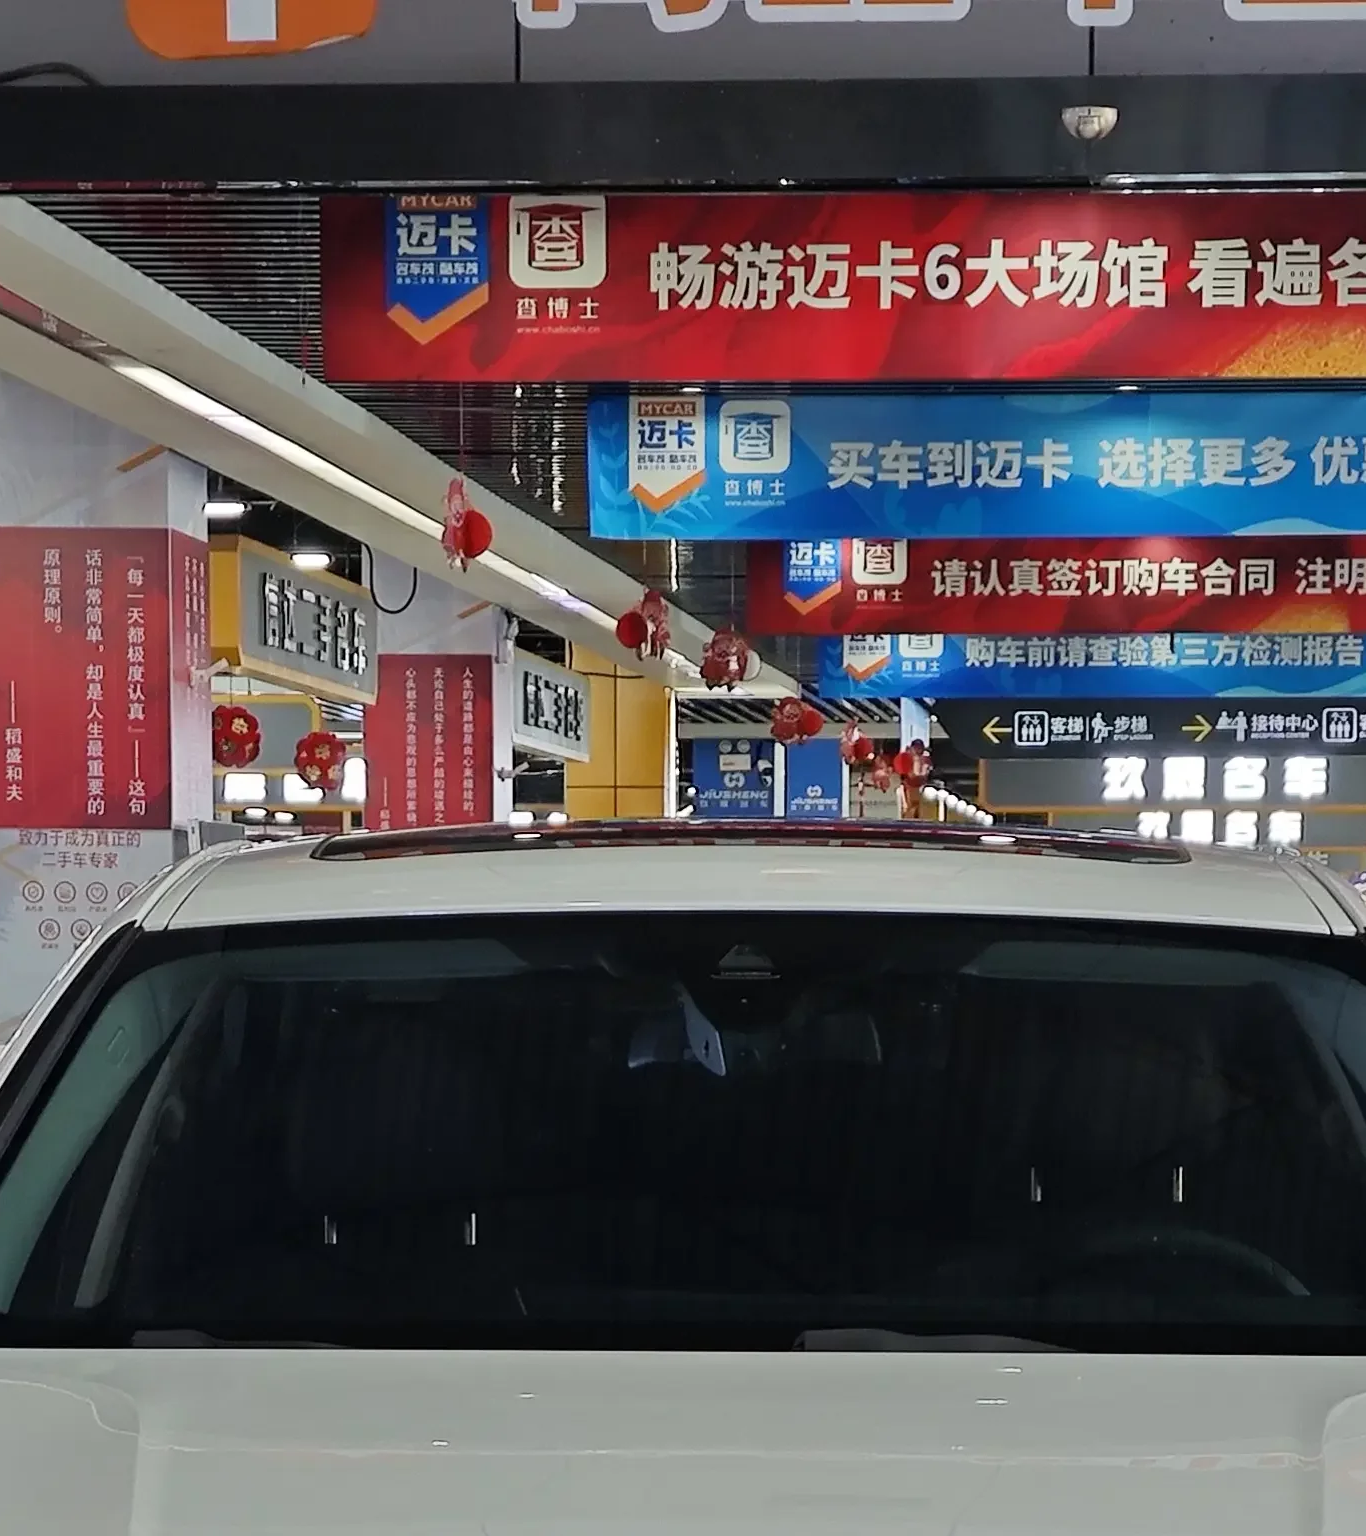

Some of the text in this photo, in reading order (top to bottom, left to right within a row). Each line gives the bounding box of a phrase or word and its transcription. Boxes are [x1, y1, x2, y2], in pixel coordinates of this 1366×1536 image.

[396, 213, 477, 257] 迈卡
[648, 239, 1167, 312] 畅游迈卡6大场馆
[516, 297, 600, 320] 查博士
[640, 403, 695, 415] MYCAR
[638, 419, 696, 449] 迈卡
[828, 439, 1072, 489] 买车到迈卡
[1097, 436, 1297, 487] 选择更多
[724, 478, 785, 496] 查博士
[789, 541, 835, 566] 迈卡
[931, 558, 1274, 598] 请认真签订购车合同
[856, 588, 904, 602] 查博士
[264, 572, 367, 676] 信达二手名车
[965, 633, 1364, 668] 购车前请查验第三方检测报告
[1051, 716, 1084, 733] 客梯
[1114, 715, 1148, 733] 步梯
[1251, 713, 1319, 732] 接待中心
[18, 829, 142, 848] 致力于成为真正的
[41, 852, 119, 869] 二手车专家
